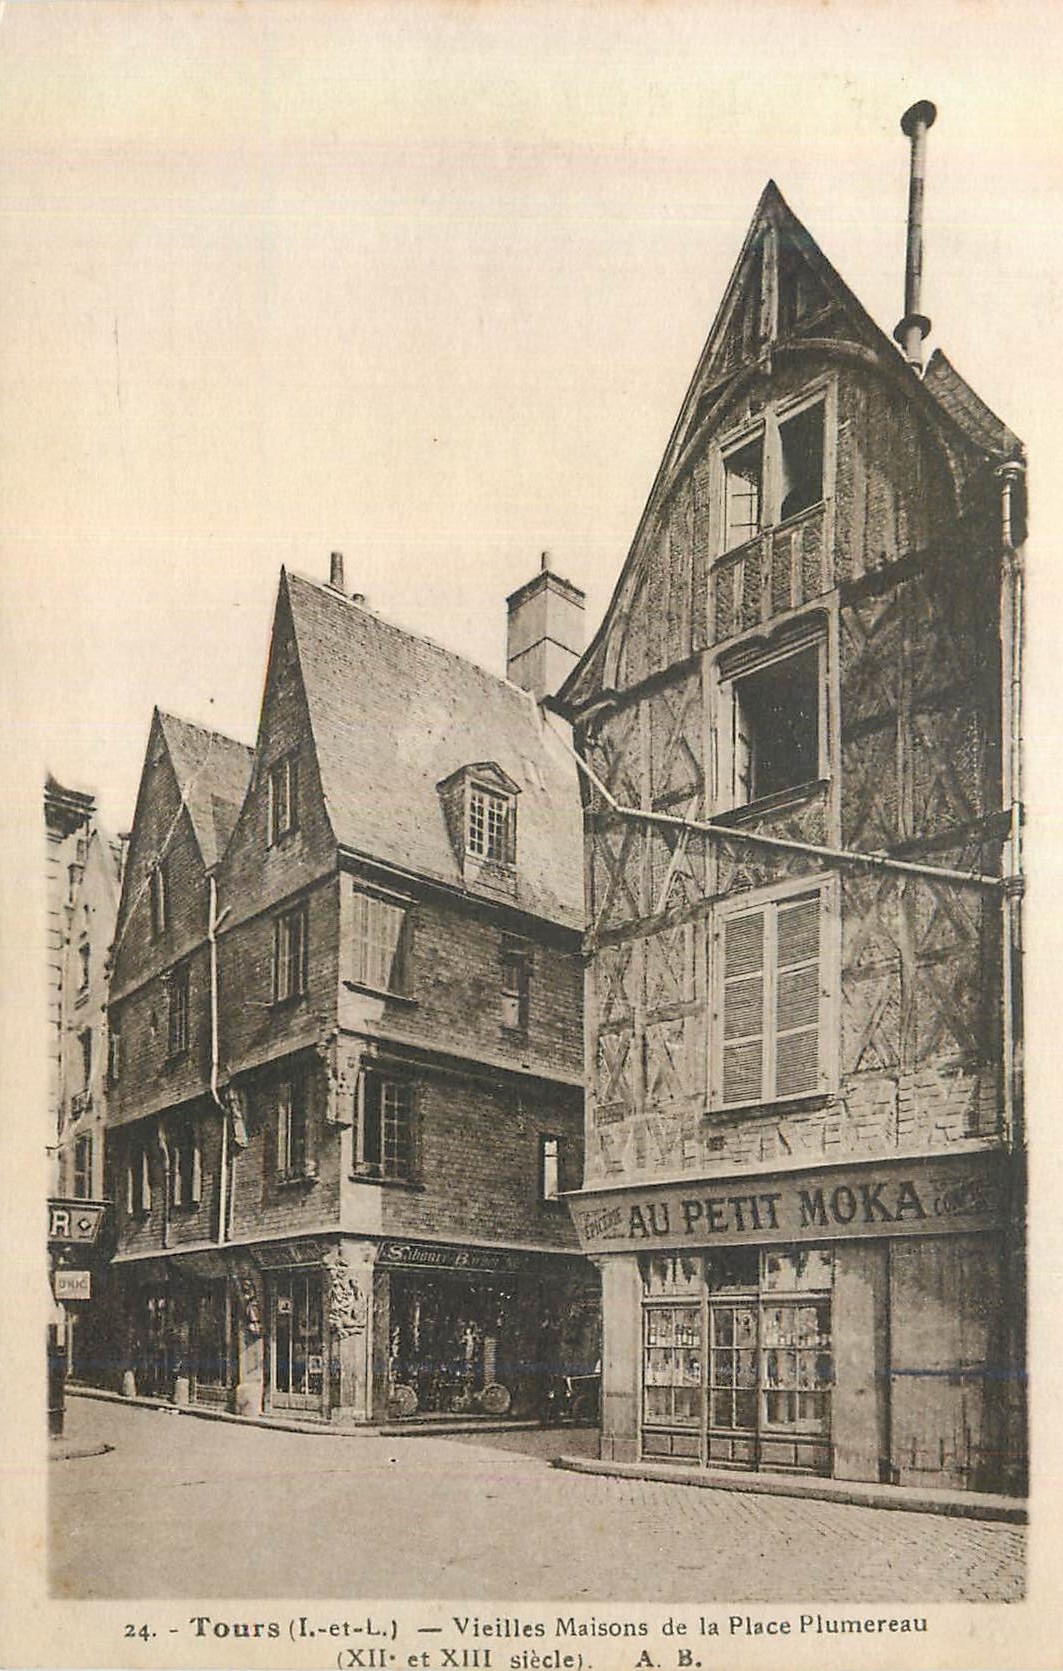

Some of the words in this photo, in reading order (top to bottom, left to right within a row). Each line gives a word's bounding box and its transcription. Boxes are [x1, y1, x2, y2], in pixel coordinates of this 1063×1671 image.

[628, 1203, 671, 1239] AU
[680, 1193, 782, 1234] PETIT
[799, 1179, 928, 1228] MOKA
